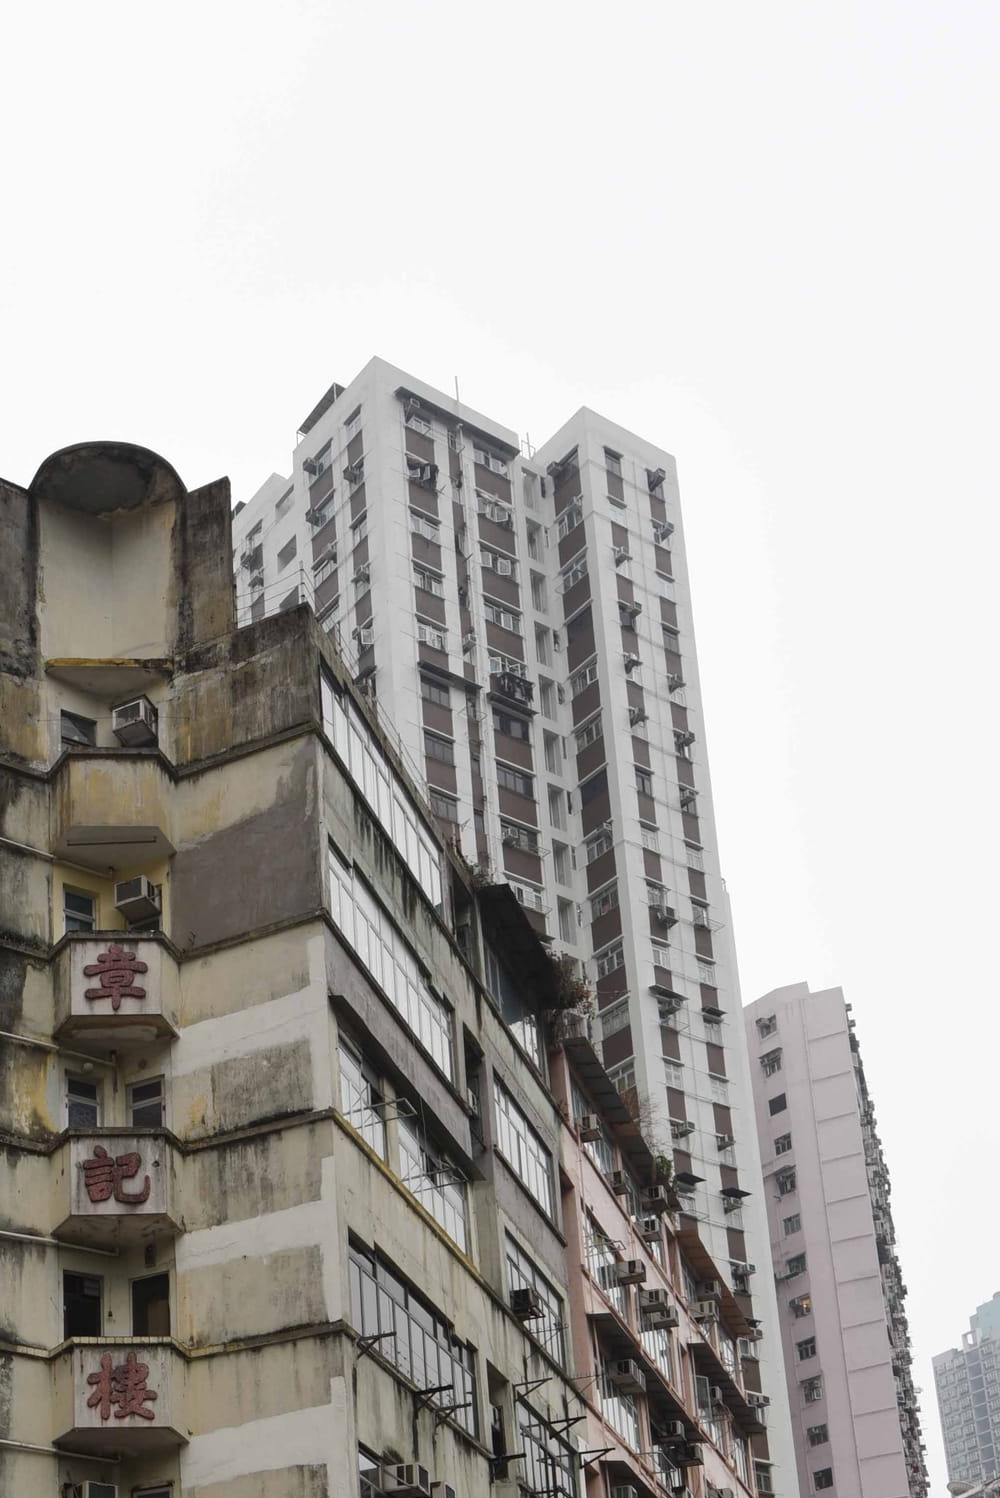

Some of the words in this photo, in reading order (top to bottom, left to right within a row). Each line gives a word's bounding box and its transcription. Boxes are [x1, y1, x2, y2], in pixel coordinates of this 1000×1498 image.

[84, 943, 148, 1010] 章
[85, 1144, 151, 1205] 記
[86, 1350, 158, 1421] 樓
